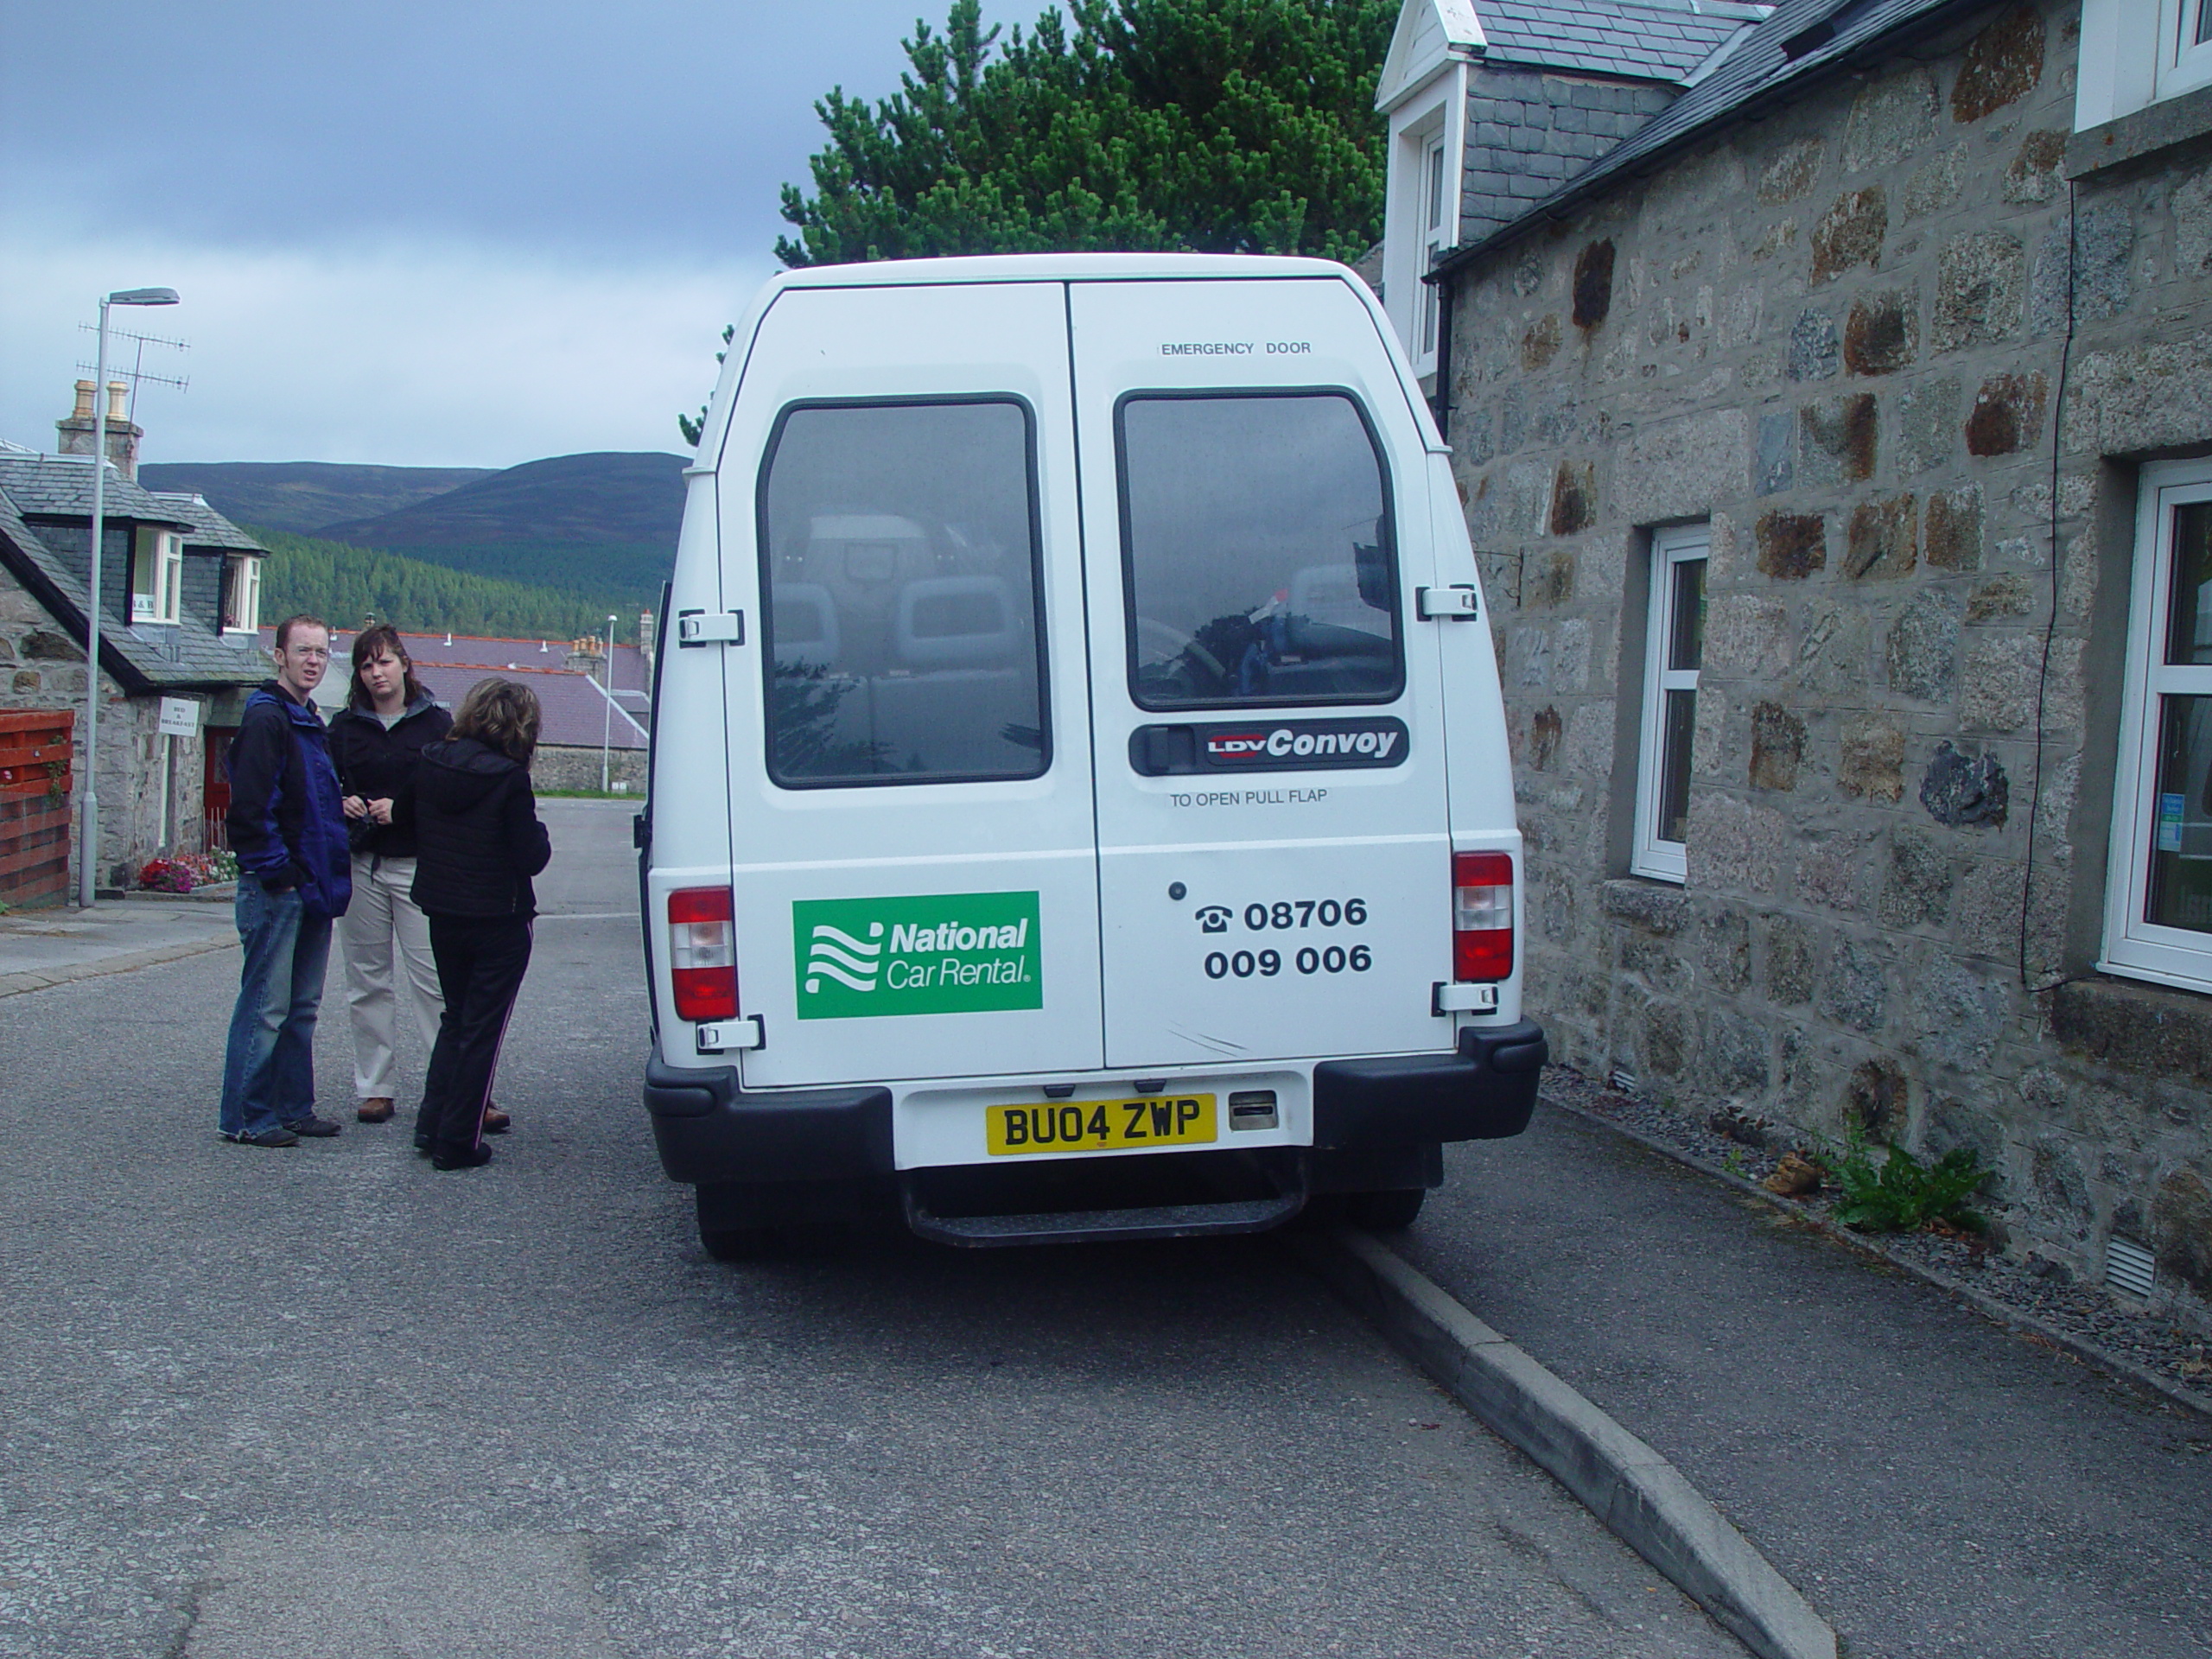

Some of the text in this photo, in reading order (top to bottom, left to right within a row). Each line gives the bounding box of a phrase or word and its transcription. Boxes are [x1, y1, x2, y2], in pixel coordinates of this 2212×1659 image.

[1161, 342, 1312, 355] EMERGENCY DOOR
[1207, 729, 1398, 758] LDV Convoy
[1170, 789, 1327, 807] TO OPEN PULL FLAP
[1244, 898, 1368, 931] 08706
[889, 918, 1028, 954] National
[887, 960, 937, 990] Car
[1205, 944, 1372, 979] 009 006
[1004, 1099, 1200, 1146] BU04 ZWP
